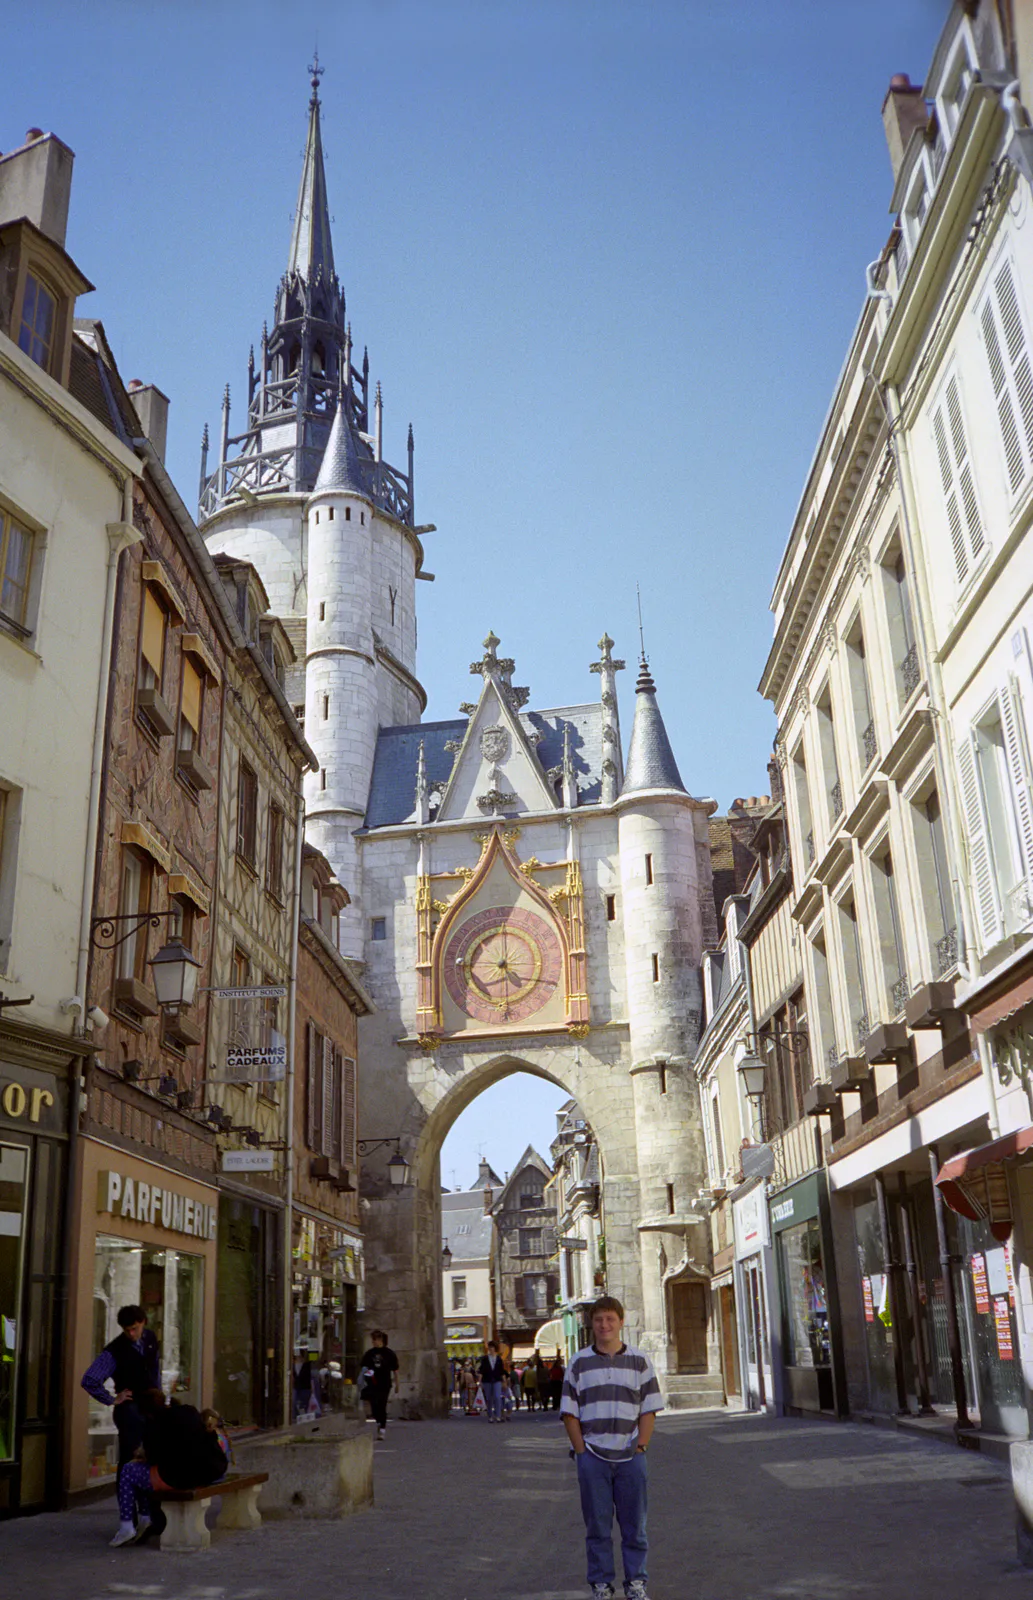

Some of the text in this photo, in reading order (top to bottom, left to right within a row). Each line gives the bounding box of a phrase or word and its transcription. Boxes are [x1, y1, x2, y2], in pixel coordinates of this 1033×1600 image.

[219, 988, 285, 998] INSTITUT SOINS
[227, 1047, 286, 1057] PARFUMS
[227, 1057, 285, 1066] CADEAUX
[107, 1170, 217, 1240] PARFUMERIE
